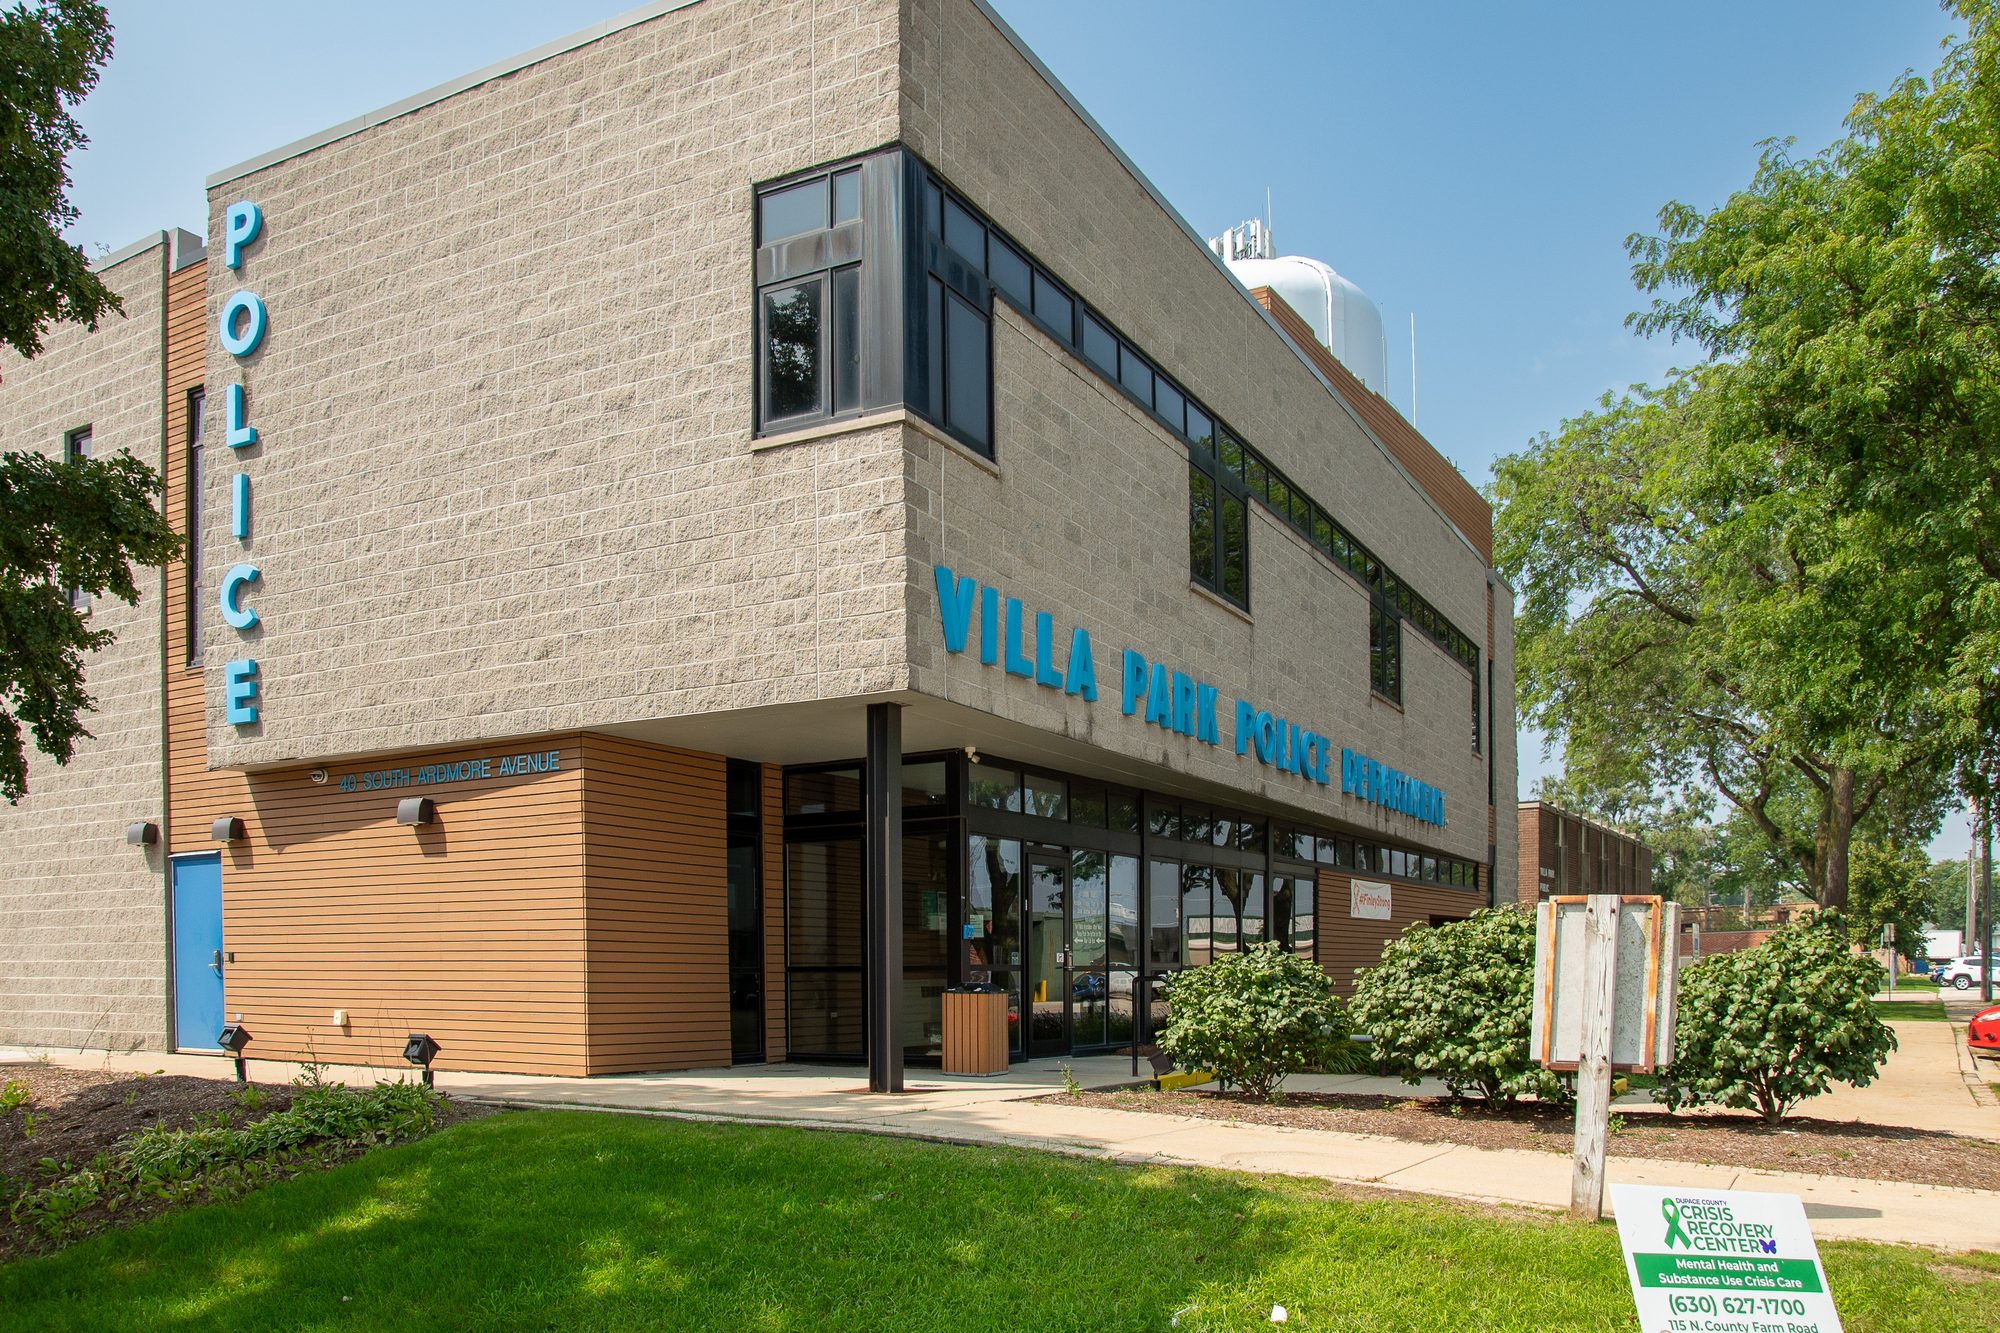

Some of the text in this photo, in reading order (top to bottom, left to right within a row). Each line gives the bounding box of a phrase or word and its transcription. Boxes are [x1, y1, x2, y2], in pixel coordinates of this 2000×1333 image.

[220, 200, 266, 726] POLICE
[935, 565, 1446, 828] VILLA PARK POLICE DEPARTMENT
[339, 751, 560, 793] 40 SOUTH ARDMORE AVENUE
[1675, 1197, 1701, 1205] DUPAGE
[1680, 1205, 1734, 1222] CRISIS
[1687, 1221, 1773, 1239] RECOVERY
[1693, 1236, 1761, 1253] CENTER
[1675, 1258, 1779, 1273] Mental Health and
[1658, 1273, 1802, 1289] Substance Use Crisis Care
[1668, 1294, 1806, 1317] (630) 627-1700
[1668, 1320, 1818, 1333] 115 N. County Farm Road
